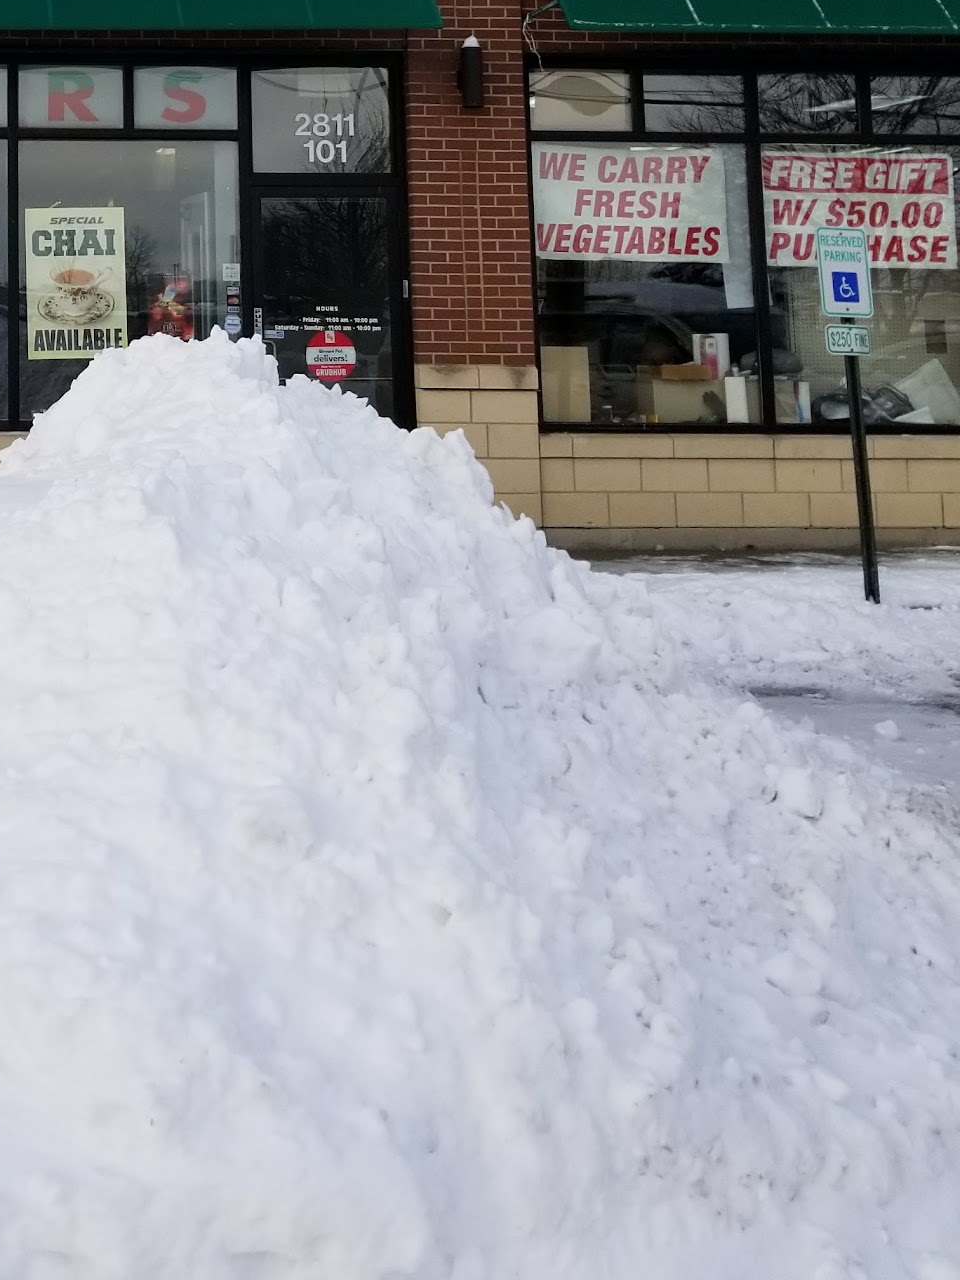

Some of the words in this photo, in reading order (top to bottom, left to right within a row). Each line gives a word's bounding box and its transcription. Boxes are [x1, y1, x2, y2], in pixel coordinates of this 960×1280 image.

[294, 113, 355, 137] 2811
[303, 139, 348, 163] 101
[539, 151, 587, 182] WE
[597, 155, 712, 184] CARRY
[769, 160, 856, 189] FREE
[865, 162, 942, 190] GIFT
[573, 188, 682, 219] FRESH
[772, 198, 818, 226] W/
[825, 198, 944, 229] $50.00
[50, 216, 104, 225] SPECIAL
[31, 229, 116, 257] CHAI
[536, 223, 721, 256] VEGETABLES
[769, 232, 950, 263] PUHASE
[820, 234, 863, 248] RESERVED
[824, 251, 862, 263] PARKING
[34, 328, 123, 352] AVAILABLE
[830, 331, 852, 348] $250
[854, 333, 869, 348] FINE
[313, 354, 348, 363] delivers!
[315, 368, 347, 376] GRUBHUB
